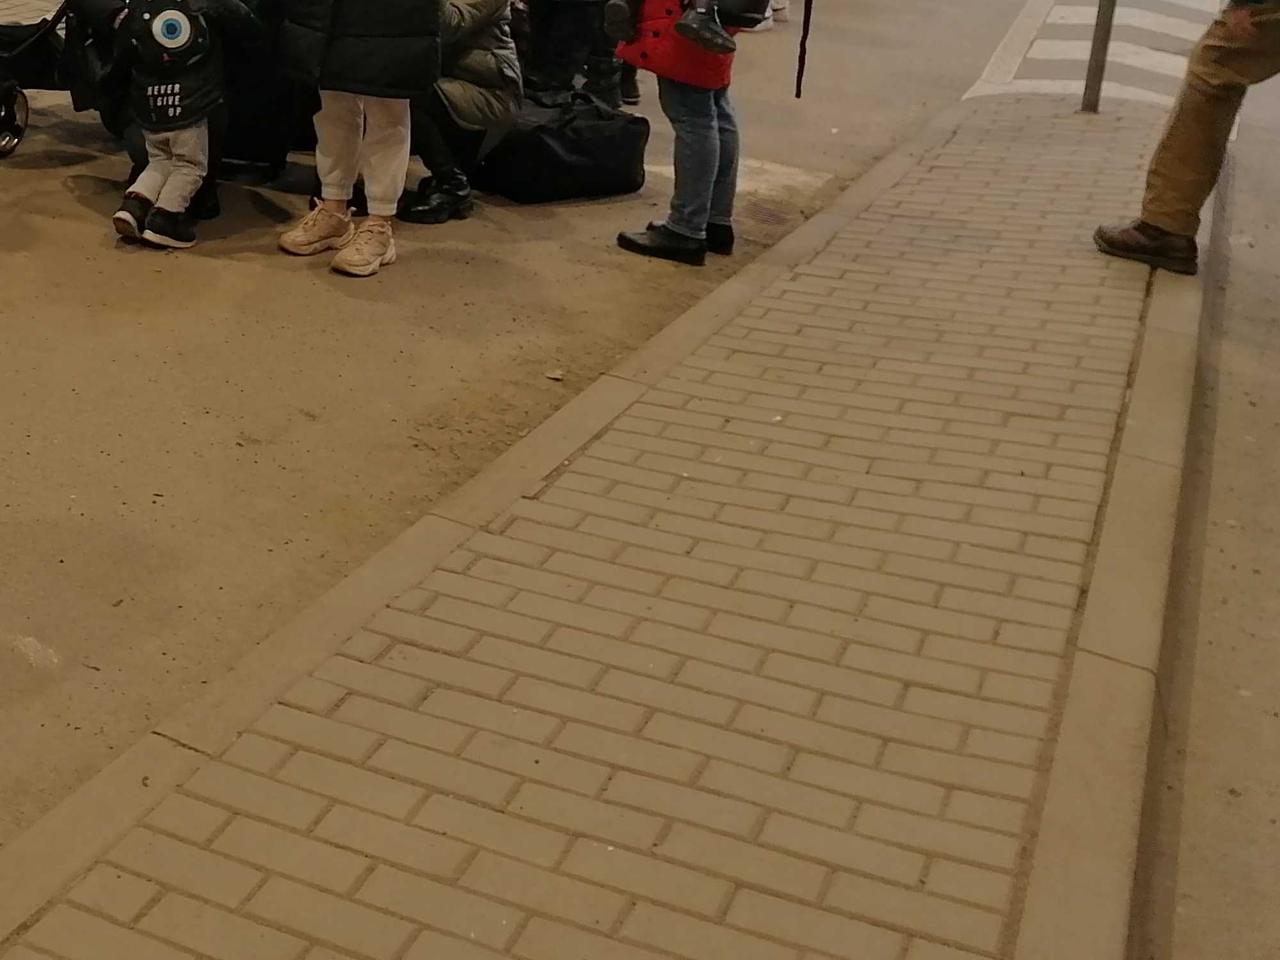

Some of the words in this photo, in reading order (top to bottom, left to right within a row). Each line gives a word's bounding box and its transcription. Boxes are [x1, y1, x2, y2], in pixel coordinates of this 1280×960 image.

[146, 83, 181, 96] NEVER
[157, 95, 180, 106] GIVE
[168, 106, 182, 117] UP
